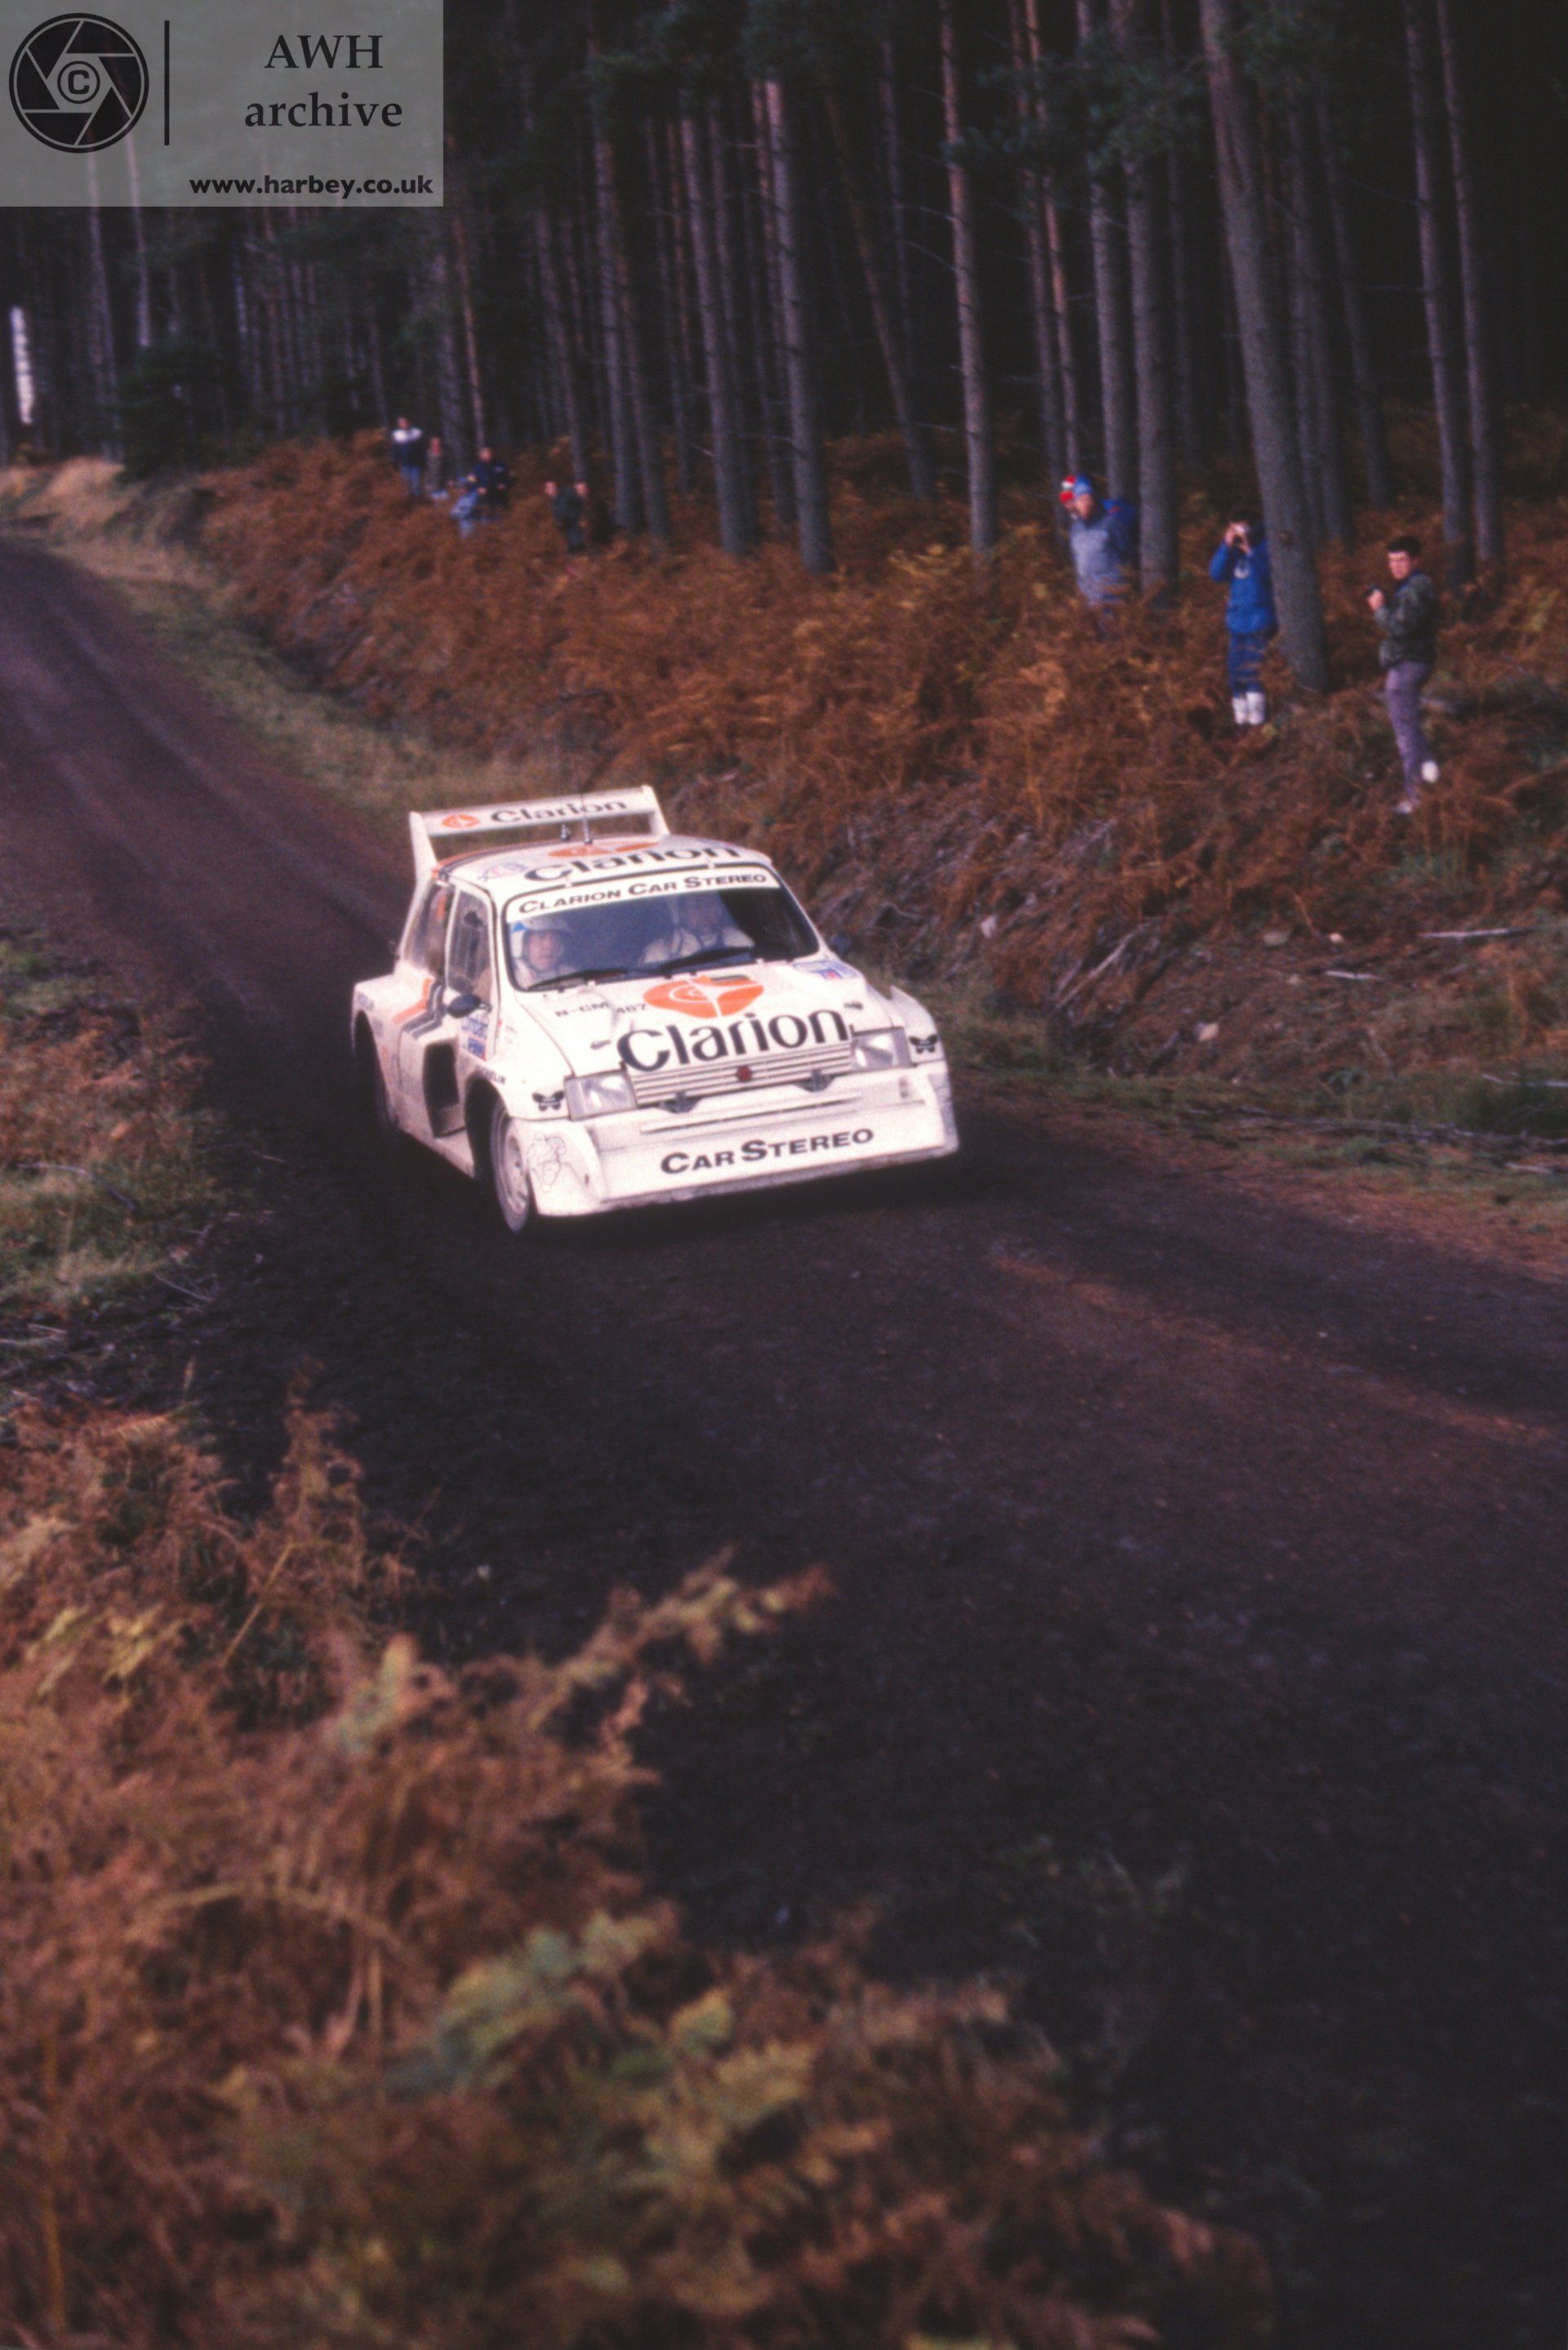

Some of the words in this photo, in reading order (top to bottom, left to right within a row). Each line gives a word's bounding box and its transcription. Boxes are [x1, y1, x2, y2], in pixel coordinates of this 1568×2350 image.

[491, 800, 628, 823] Clarion
[524, 847, 742, 881] Clarion
[518, 888, 621, 914] CLARION
[628, 882, 678, 896] CAR
[684, 874, 768, 889] STEREO
[617, 1009, 849, 1072] Clarion
[660, 1152, 735, 1175] CAR
[741, 1128, 875, 1162] STEREO
